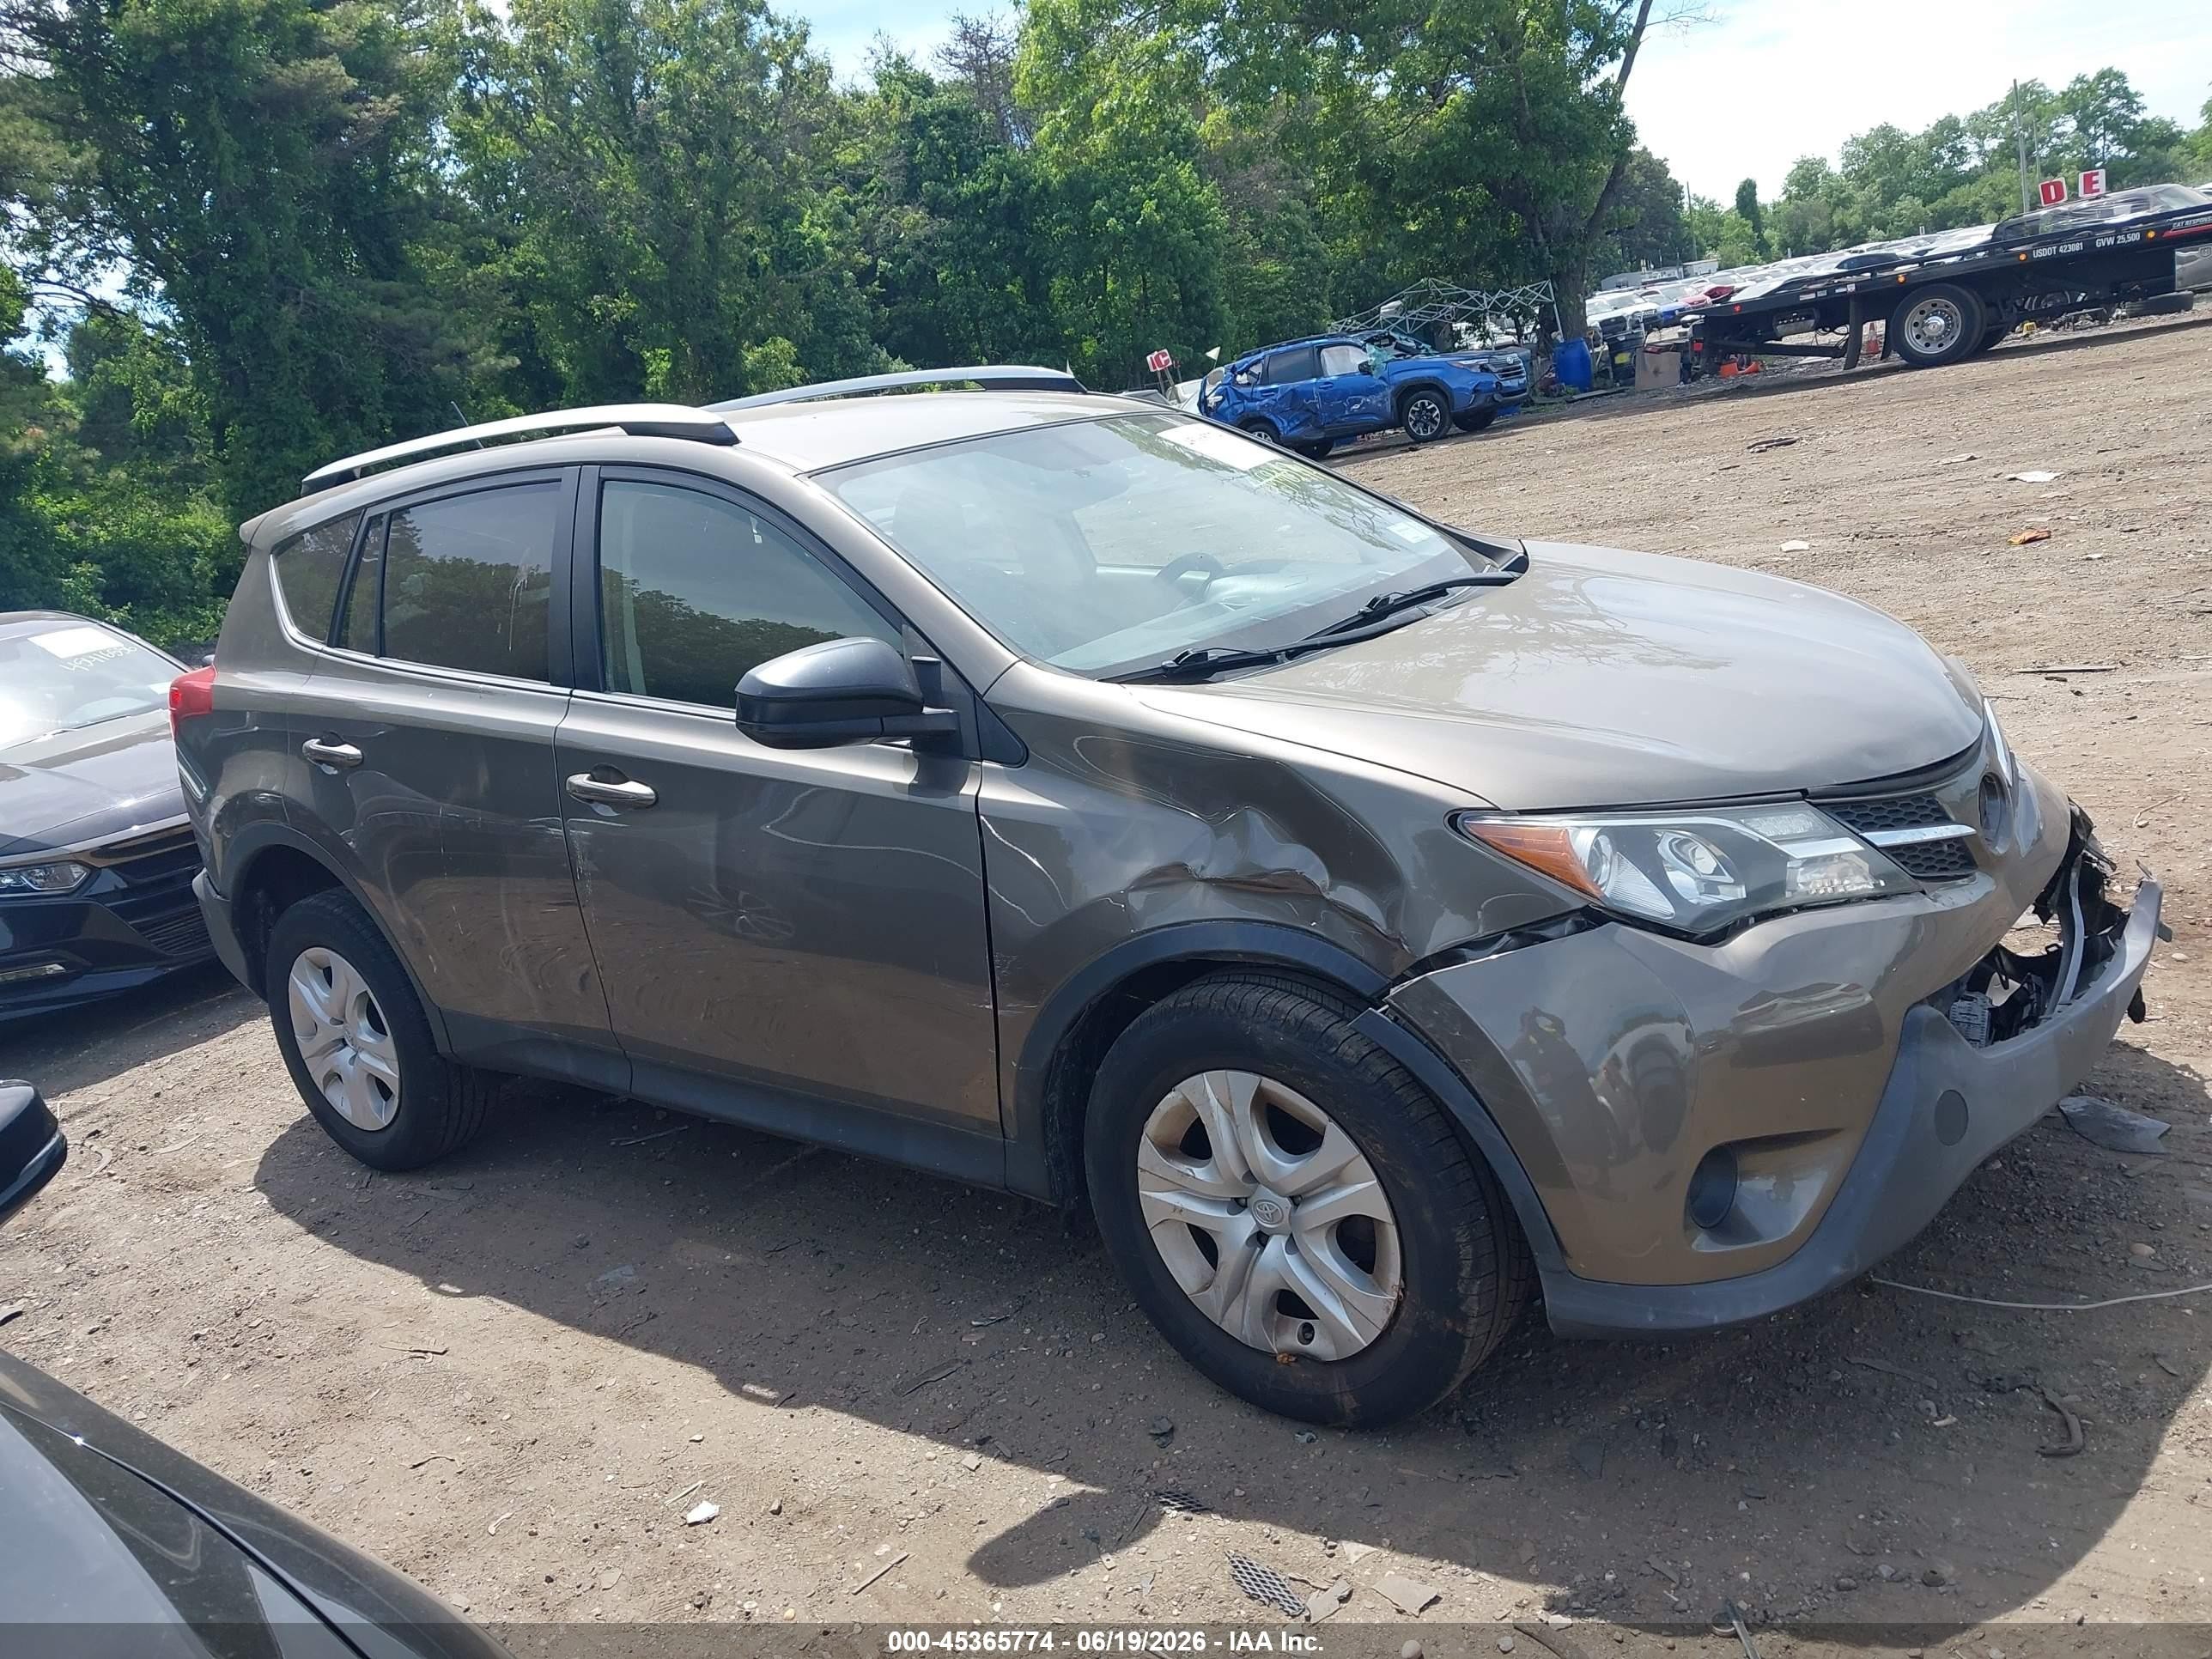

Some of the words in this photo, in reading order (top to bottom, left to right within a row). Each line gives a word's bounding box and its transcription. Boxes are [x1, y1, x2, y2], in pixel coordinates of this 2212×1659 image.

[2040, 179, 2065, 205] D
[2082, 172, 2100, 194] E
[2033, 246, 2057, 258] USDOT
[2058, 241, 2084, 253] 423081
[2095, 236, 2115, 248] GVW
[2116, 232, 2141, 244] 25,500
